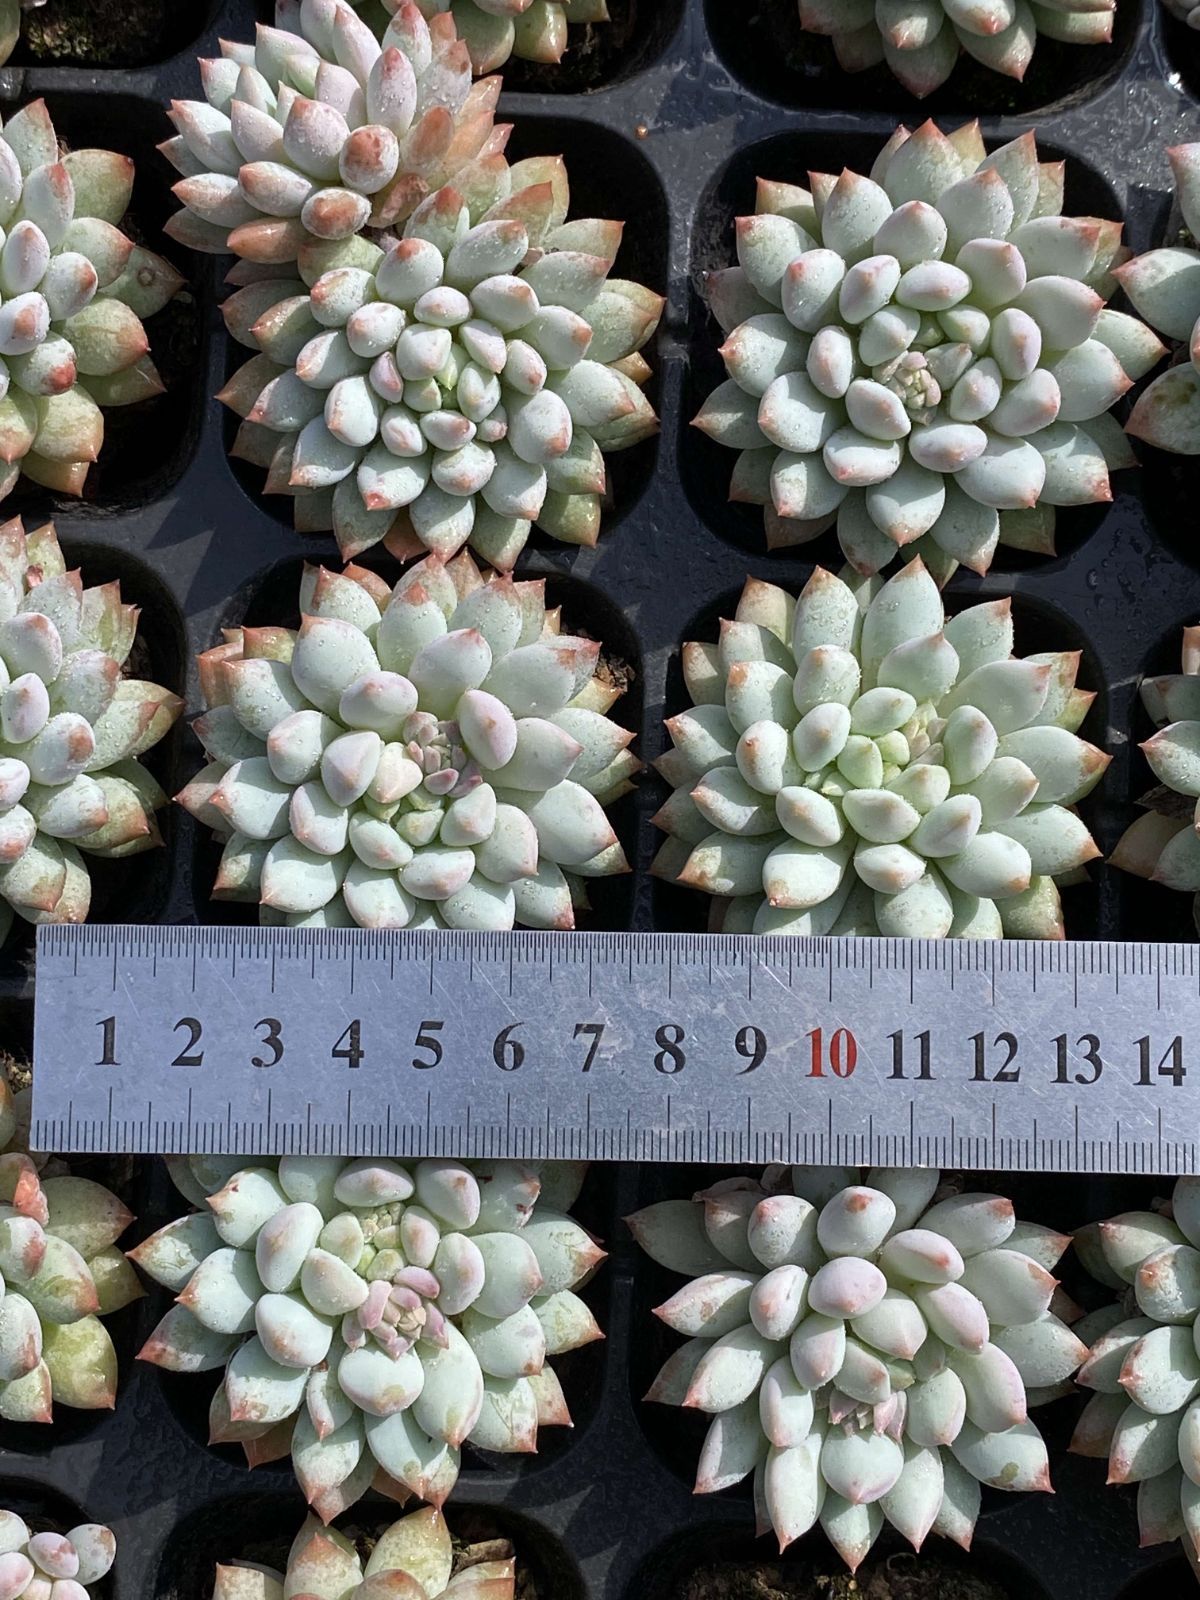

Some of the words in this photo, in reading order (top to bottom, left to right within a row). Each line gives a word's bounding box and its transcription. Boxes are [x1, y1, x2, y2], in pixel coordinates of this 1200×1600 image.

[95, 1016, 121, 1065] 1
[171, 1017, 204, 1066] 2
[251, 1018, 284, 1068] 3
[331, 1019, 364, 1068] 4
[412, 1020, 444, 1069] 5
[492, 1021, 525, 1071] 6
[573, 1023, 604, 1072] 7
[653, 1024, 686, 1074] 8
[734, 1026, 767, 1075] 9
[805, 1027, 858, 1078] 10
[887, 1029, 937, 1080] 11
[968, 1031, 1021, 1082] 12
[1050, 1033, 1103, 1084] 13
[1132, 1035, 1187, 1086] 14
